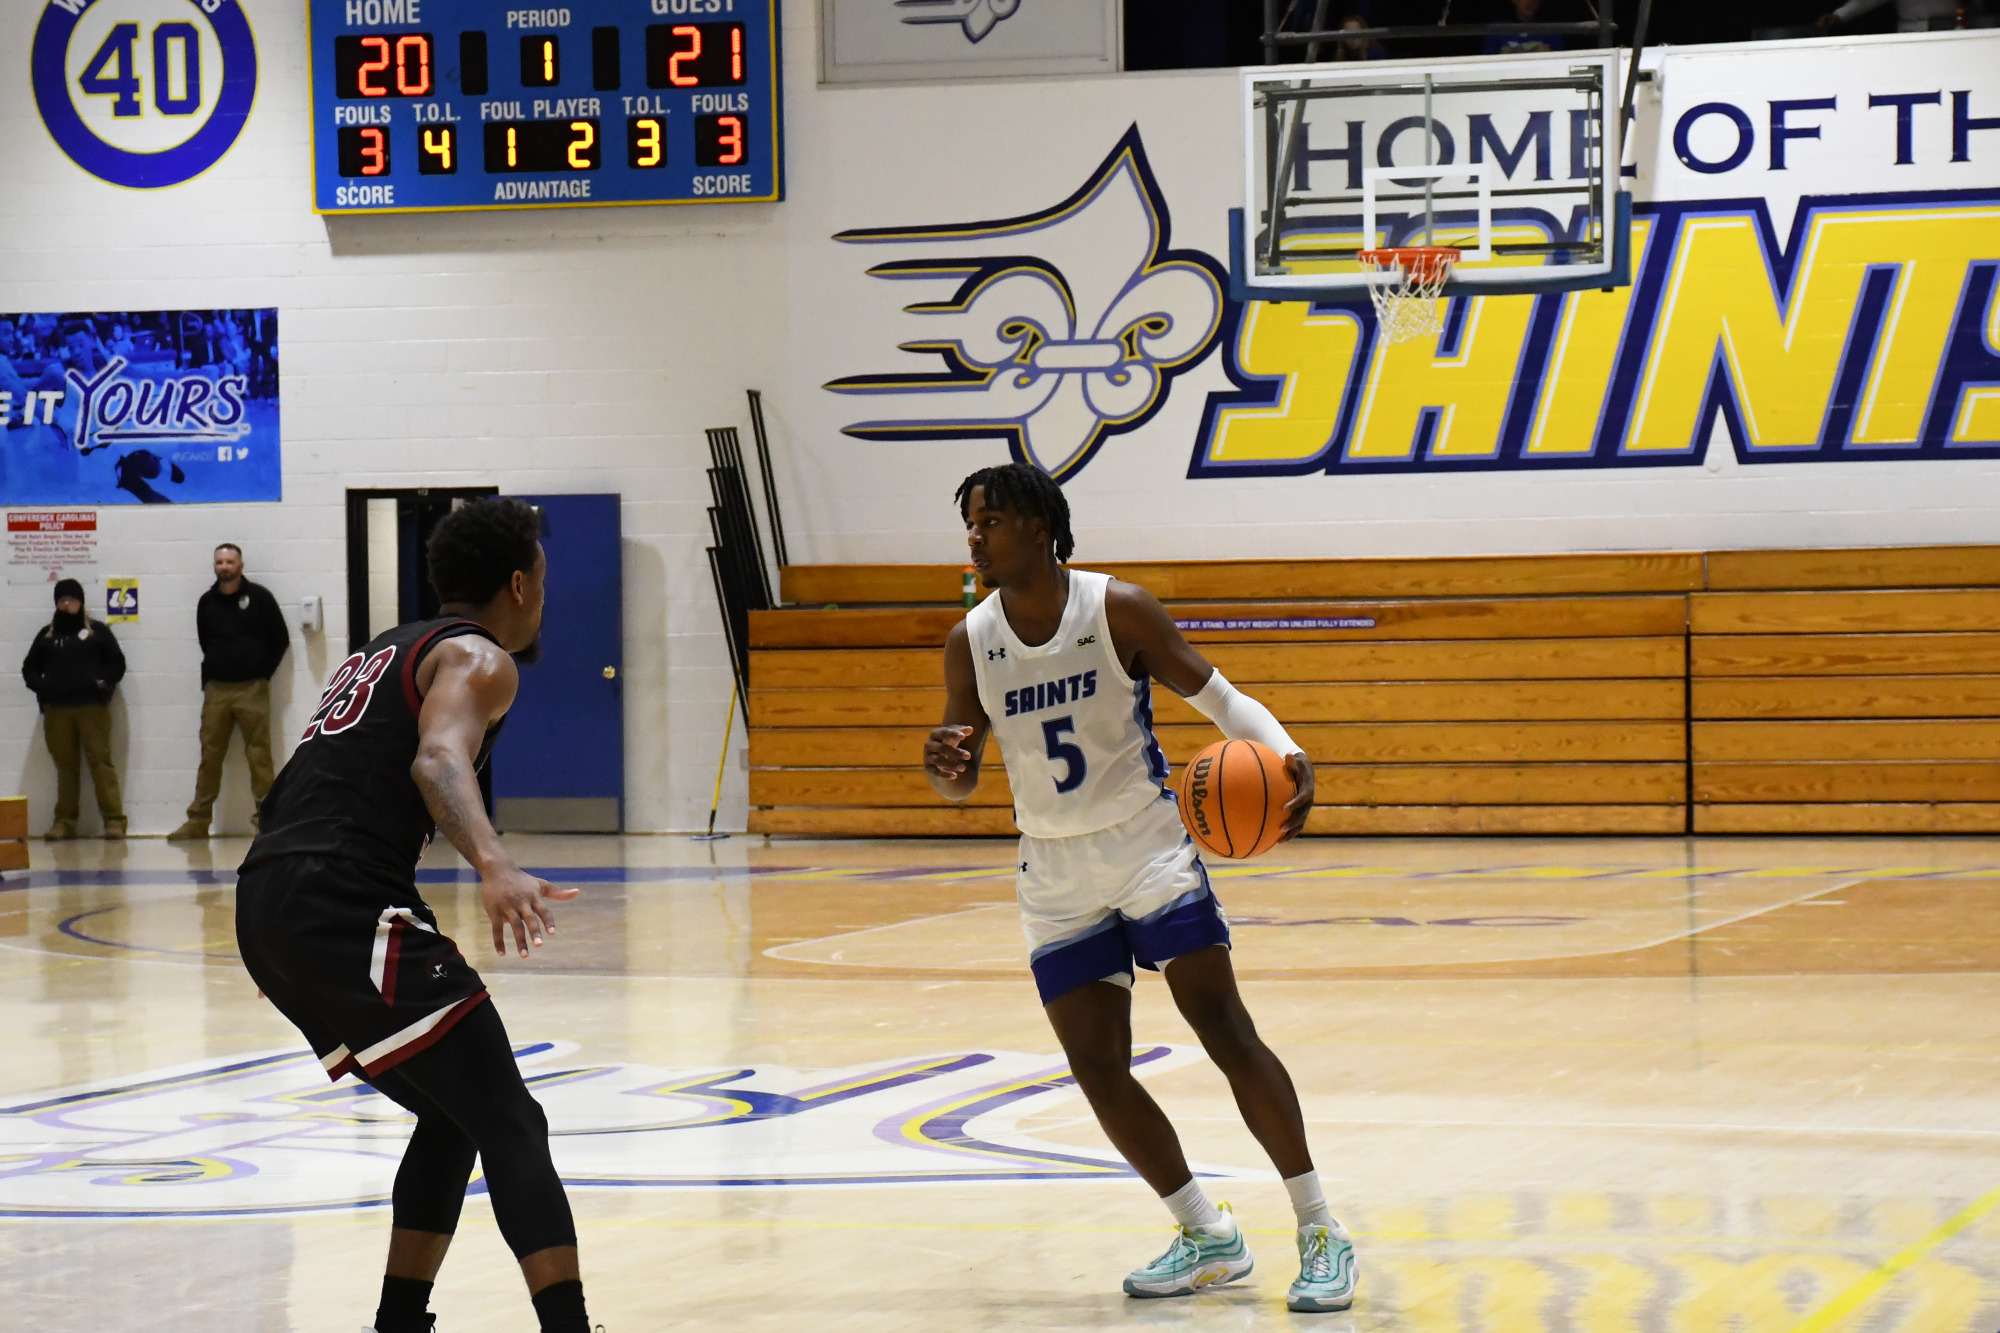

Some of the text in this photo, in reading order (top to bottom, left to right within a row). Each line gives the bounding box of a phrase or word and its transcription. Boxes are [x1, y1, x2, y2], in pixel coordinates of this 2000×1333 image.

[345, 0, 421, 26] HOME
[507, 8, 571, 29] PERIOD
[651, 0, 735, 15] GUEST
[78, 20, 202, 119] 40
[358, 35, 430, 97] 20
[543, 40, 554, 82] 1
[669, 26, 741, 87] 21
[334, 104, 392, 125] FOULS
[412, 103, 462, 123] T.O.L.
[481, 97, 601, 120] FOUL PLAYER
[622, 95, 671, 115] T.O.L.
[691, 93, 750, 113] FOULS
[360, 128, 385, 176] 3
[423, 129, 452, 170] 4
[636, 119, 661, 167] 3
[717, 116, 742, 164] 3
[1291, 105, 1638, 192] HOME
[1673, 95, 1838, 175] OF
[336, 184, 395, 207] SCORE
[494, 179, 592, 201] ADVANTAGE
[692, 174, 752, 195] SCORE
[22, 390, 65, 426] IT
[65, 355, 248, 449] YOURS
[1077, 635, 1096, 647] SAC
[299, 644, 397, 745] 23
[1004, 669, 1097, 717] SAINTS
[1041, 714, 1088, 795] 5
[1191, 756, 1214, 836] Wilson
